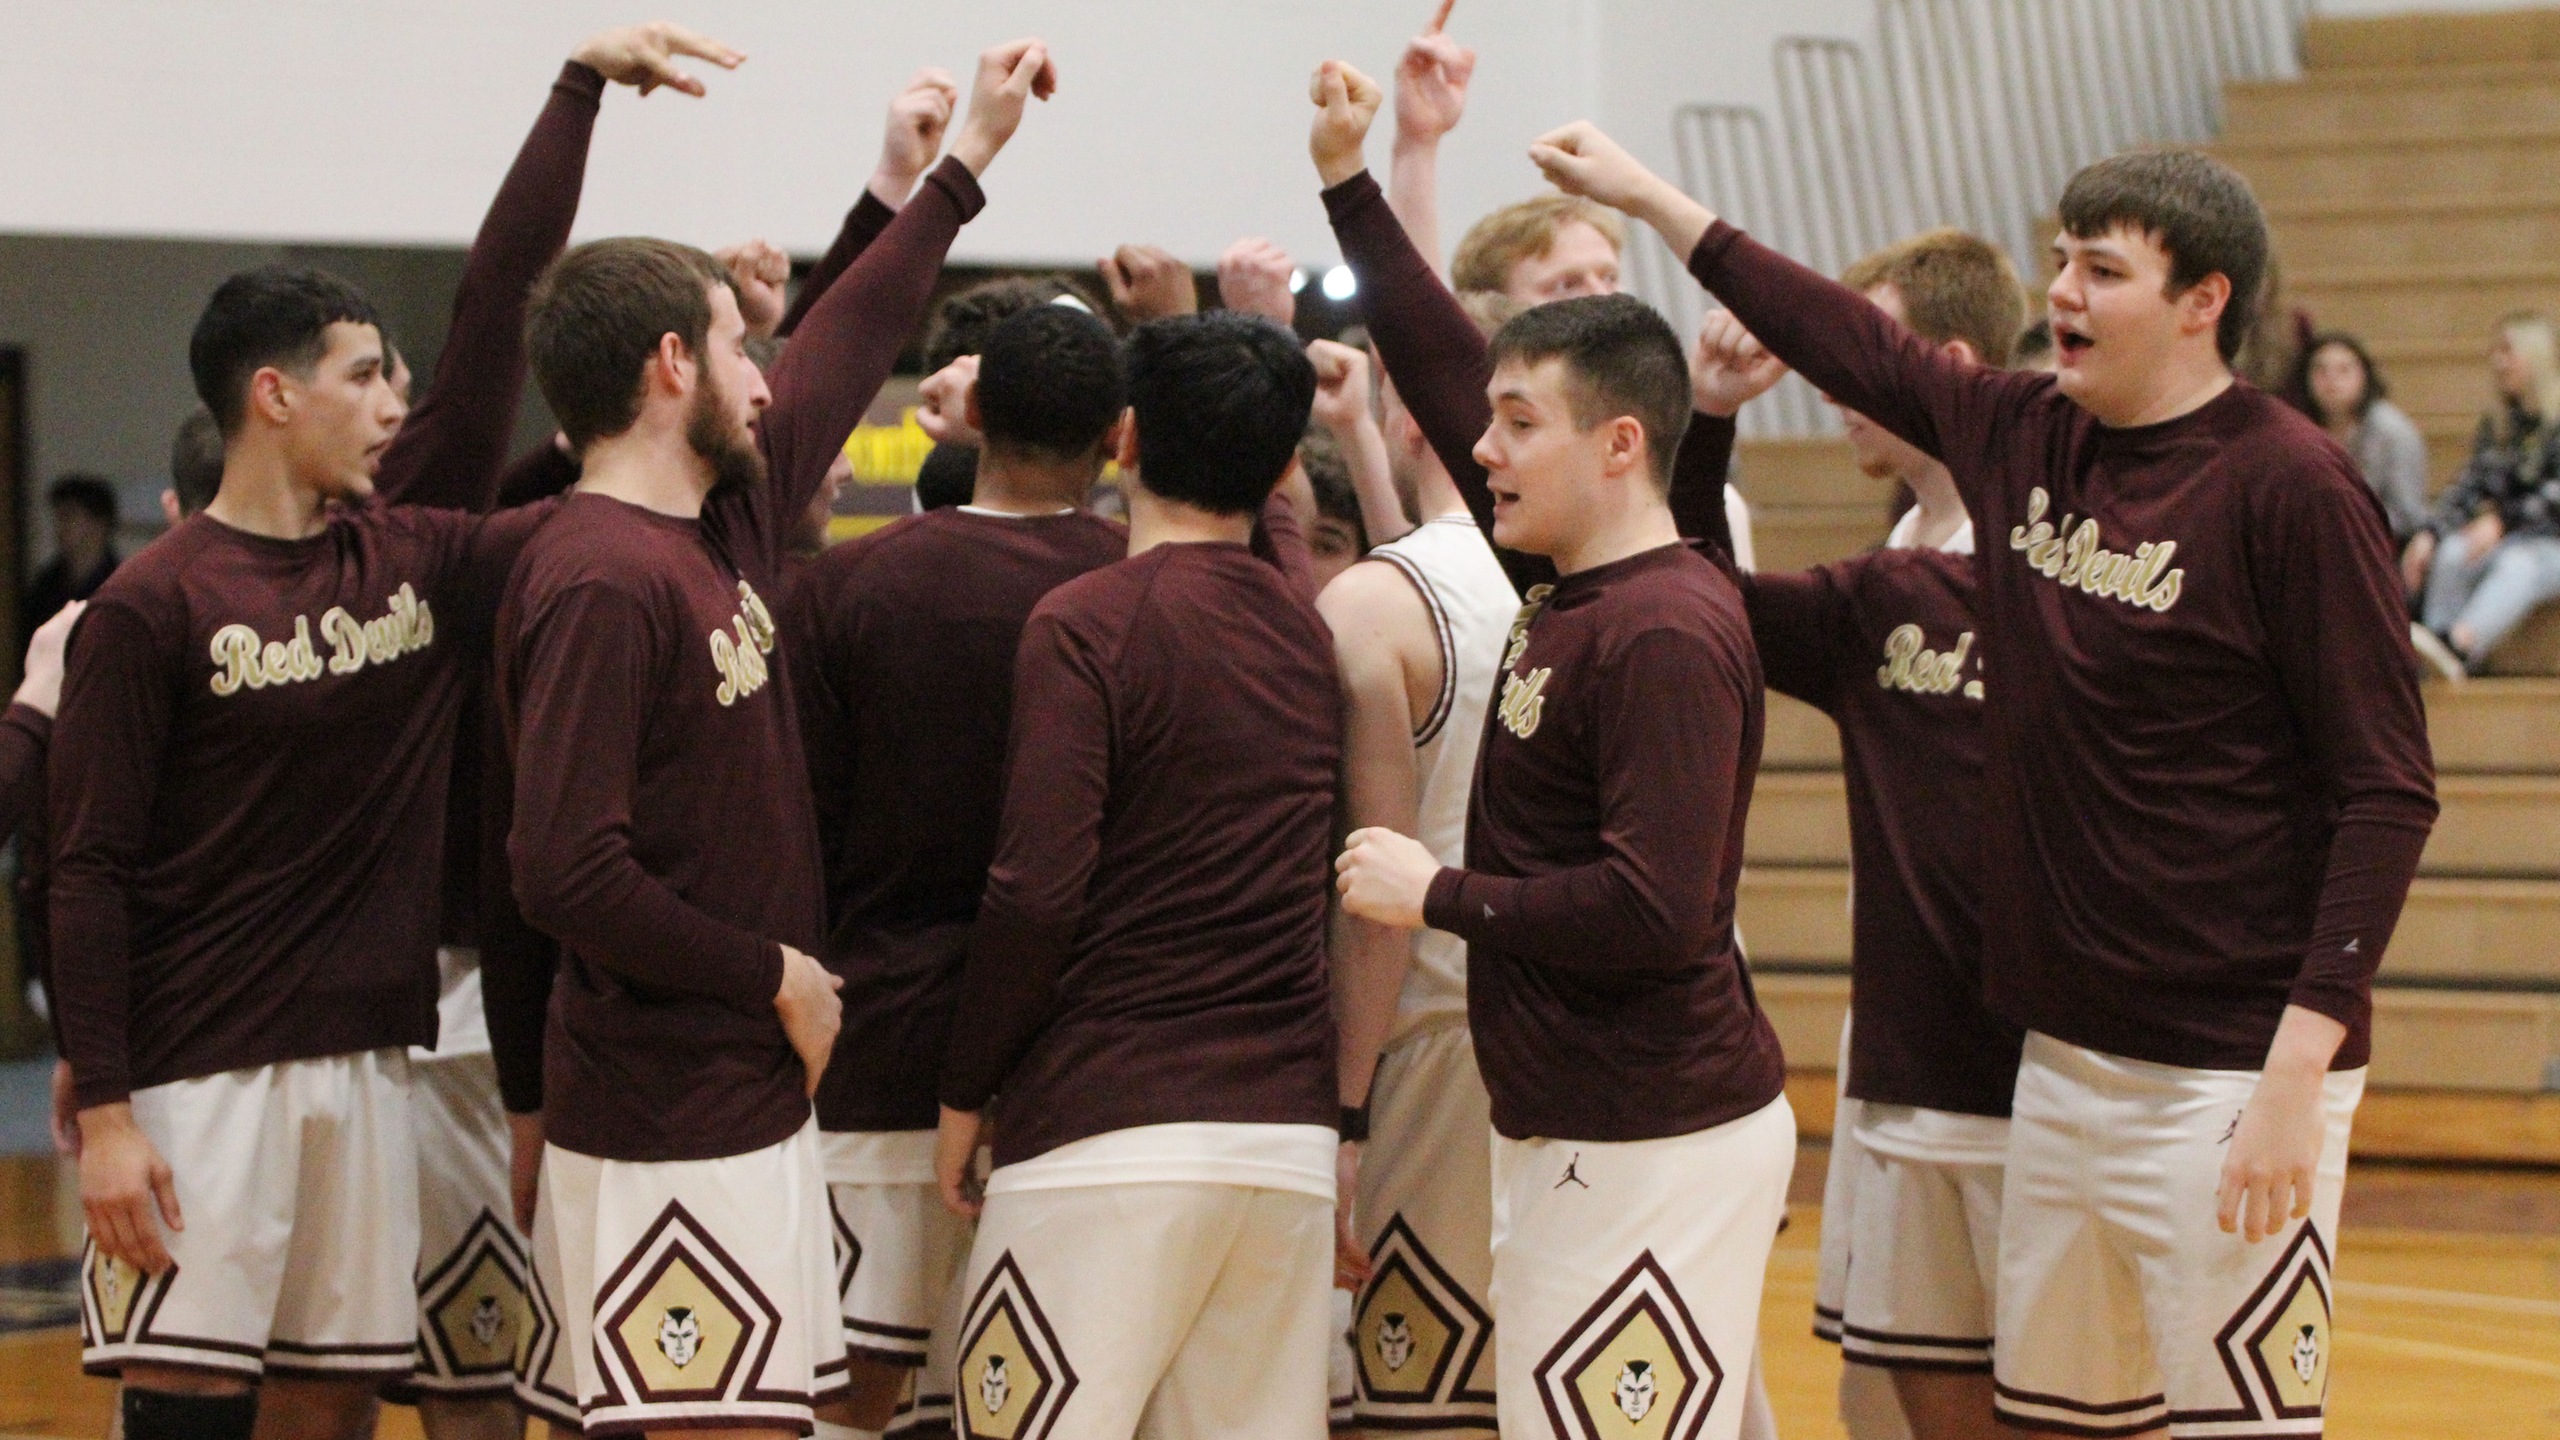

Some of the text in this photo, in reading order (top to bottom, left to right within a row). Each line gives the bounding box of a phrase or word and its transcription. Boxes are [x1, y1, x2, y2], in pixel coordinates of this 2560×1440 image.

[2060, 516, 2185, 612] Devils
[209, 581, 434, 696] Red Devils
[1877, 623, 1975, 693] Red
